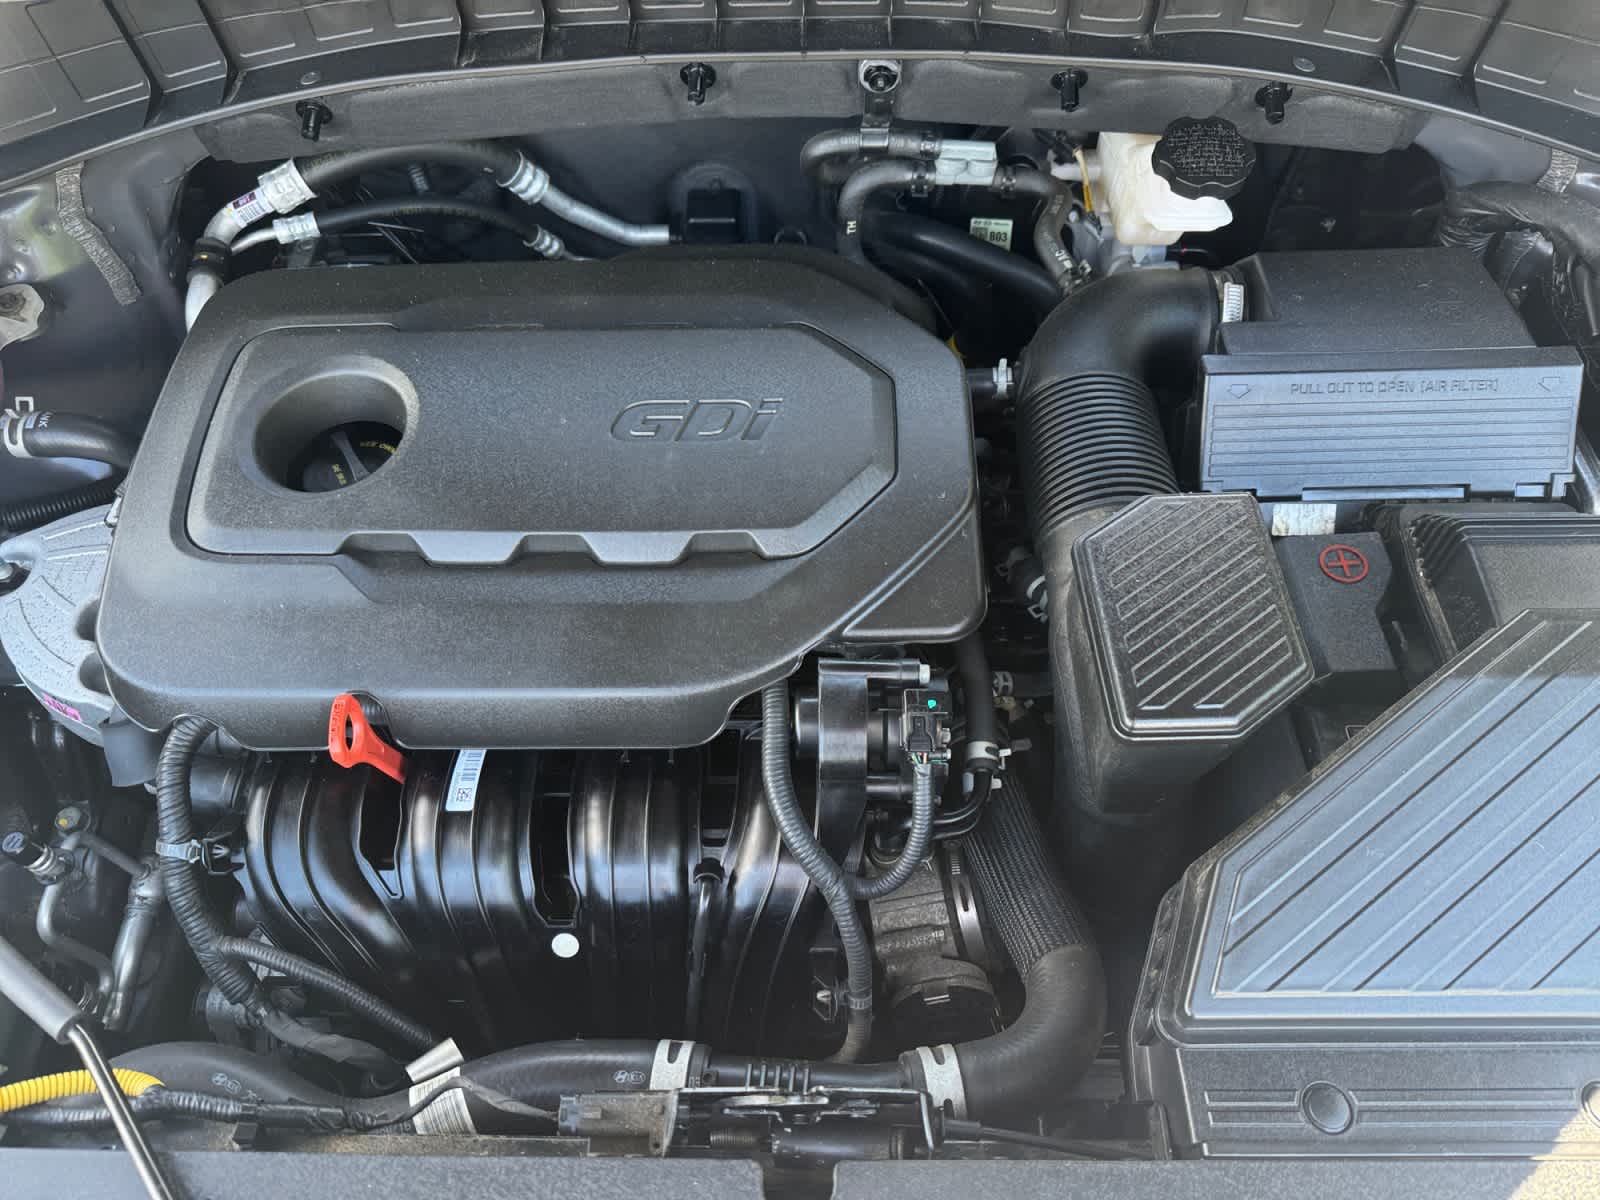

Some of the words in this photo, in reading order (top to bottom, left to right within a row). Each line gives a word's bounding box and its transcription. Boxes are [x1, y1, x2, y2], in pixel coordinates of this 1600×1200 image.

[1291, 383, 1324, 395] PULL
[1328, 382, 1354, 394] OUT
[1358, 381, 1374, 393] TO
[1379, 380, 1414, 393] OPEN
[610, 397, 784, 442] GDi
